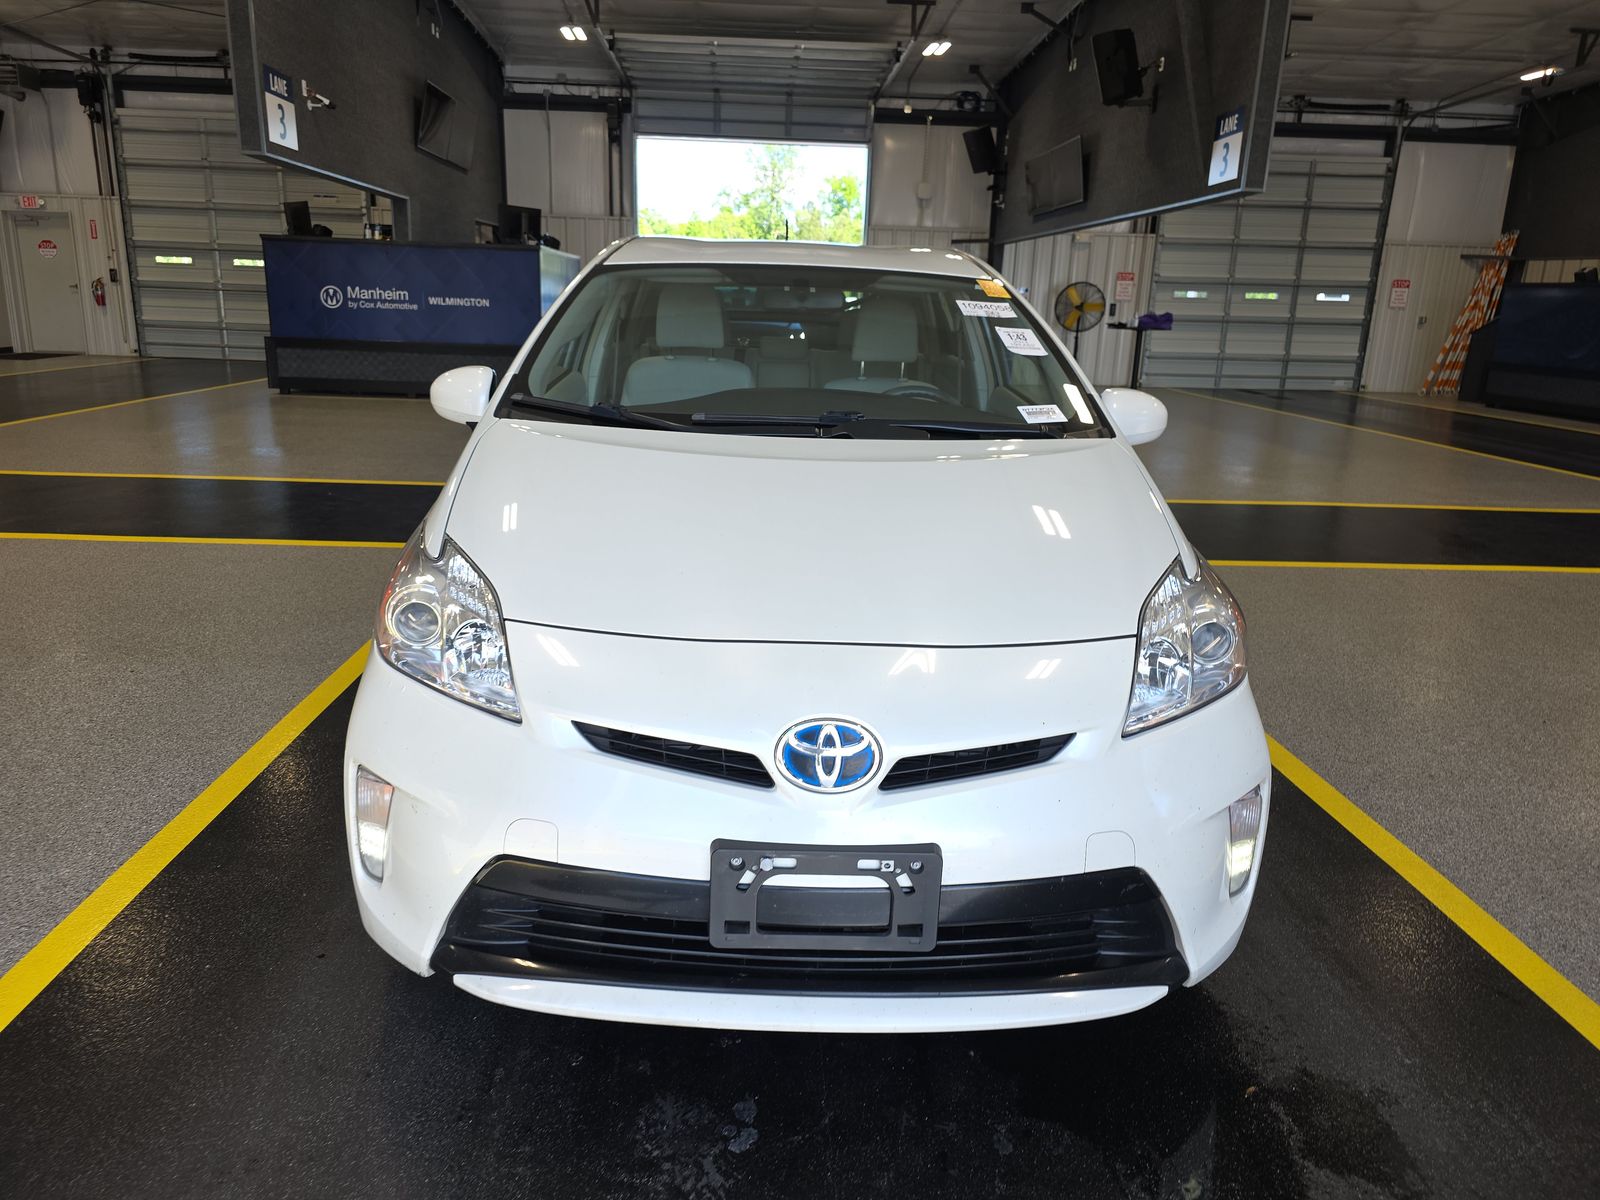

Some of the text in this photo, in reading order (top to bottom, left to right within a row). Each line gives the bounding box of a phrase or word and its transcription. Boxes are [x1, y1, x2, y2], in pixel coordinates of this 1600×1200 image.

[269, 72, 288, 97] LANE
[278, 103, 287, 140] 3
[1219, 113, 1239, 135] LANE
[1218, 142, 1230, 177] 3
[23, 196, 36, 207] EXIT
[346, 286, 409, 300] Manheim
[428, 296, 490, 307] WILMINGTON
[348, 301, 418, 310] by Cox Automotive
